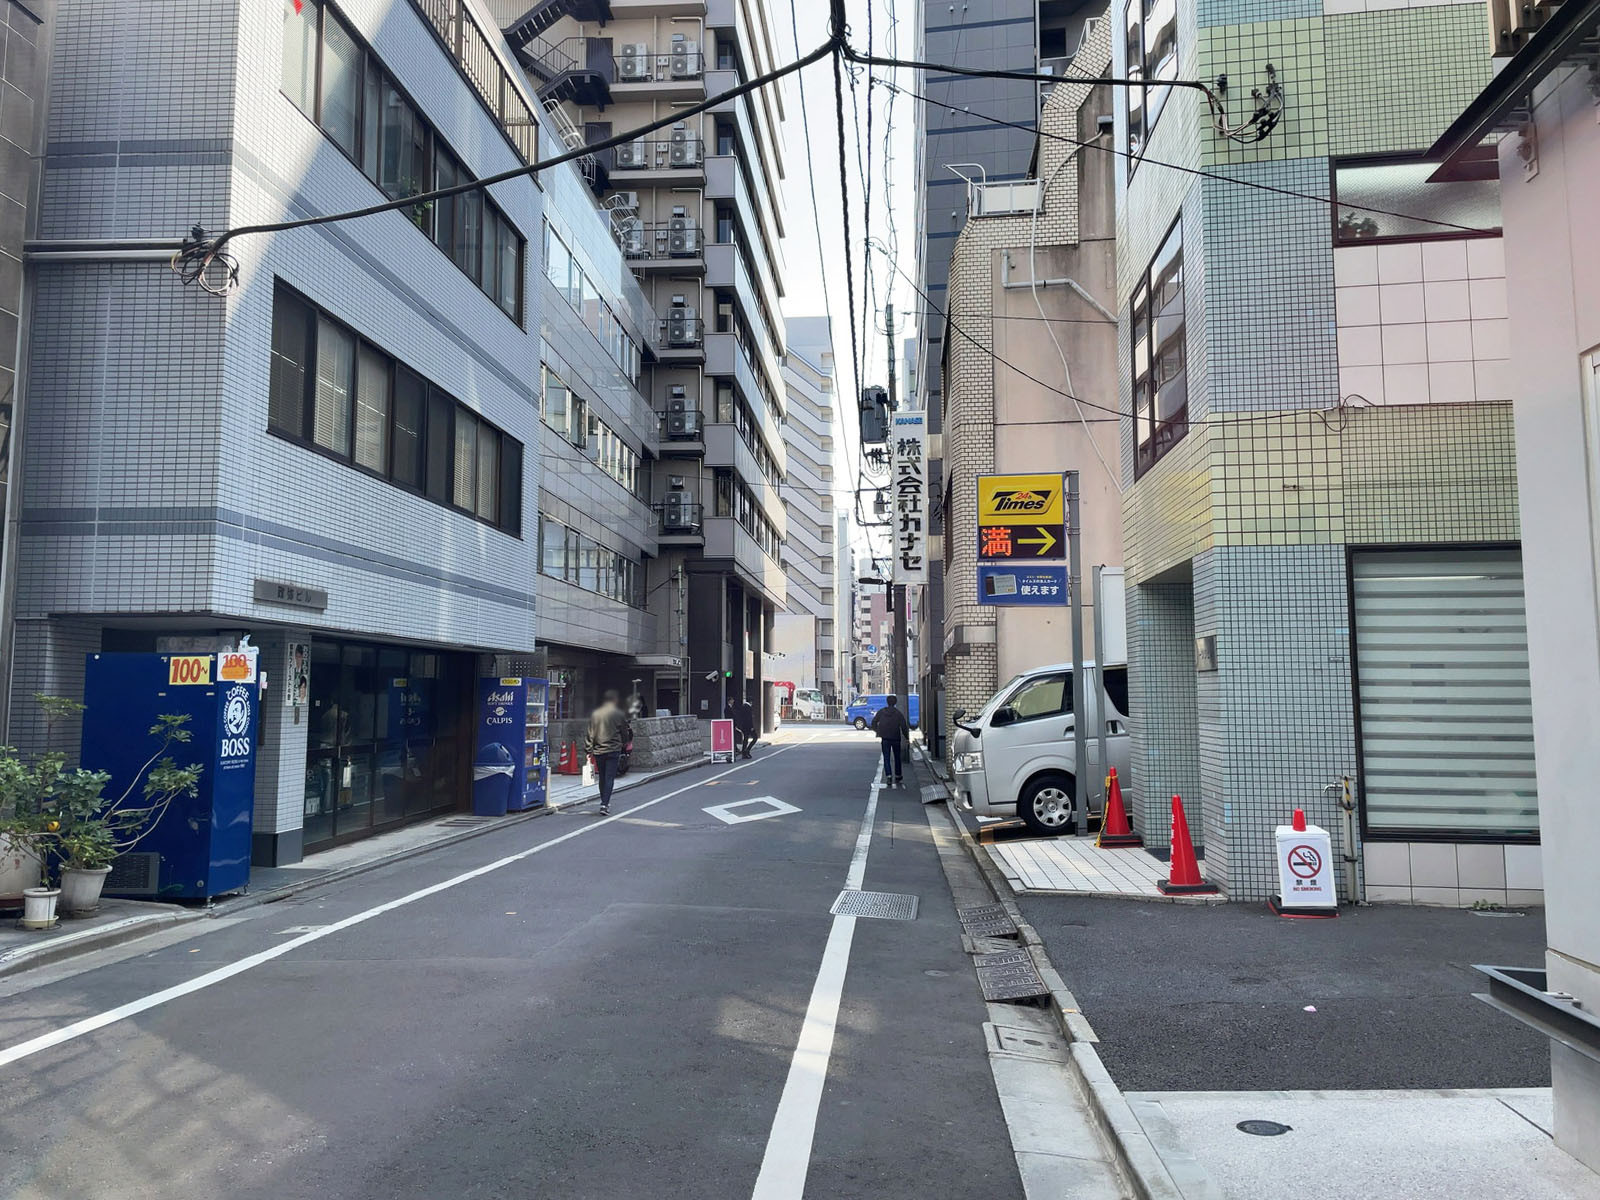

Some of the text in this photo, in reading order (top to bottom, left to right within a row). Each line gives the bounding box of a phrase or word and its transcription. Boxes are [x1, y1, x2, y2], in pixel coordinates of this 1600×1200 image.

[897, 437, 923, 571] 株式会社カナセ
[992, 490, 1052, 512] Times
[981, 527, 1012, 557] 満
[1021, 585, 1060, 596] 使えます
[487, 691, 514, 701] Asahi
[486, 717, 512, 725] CALPIS
[221, 737, 250, 757] BOSS
